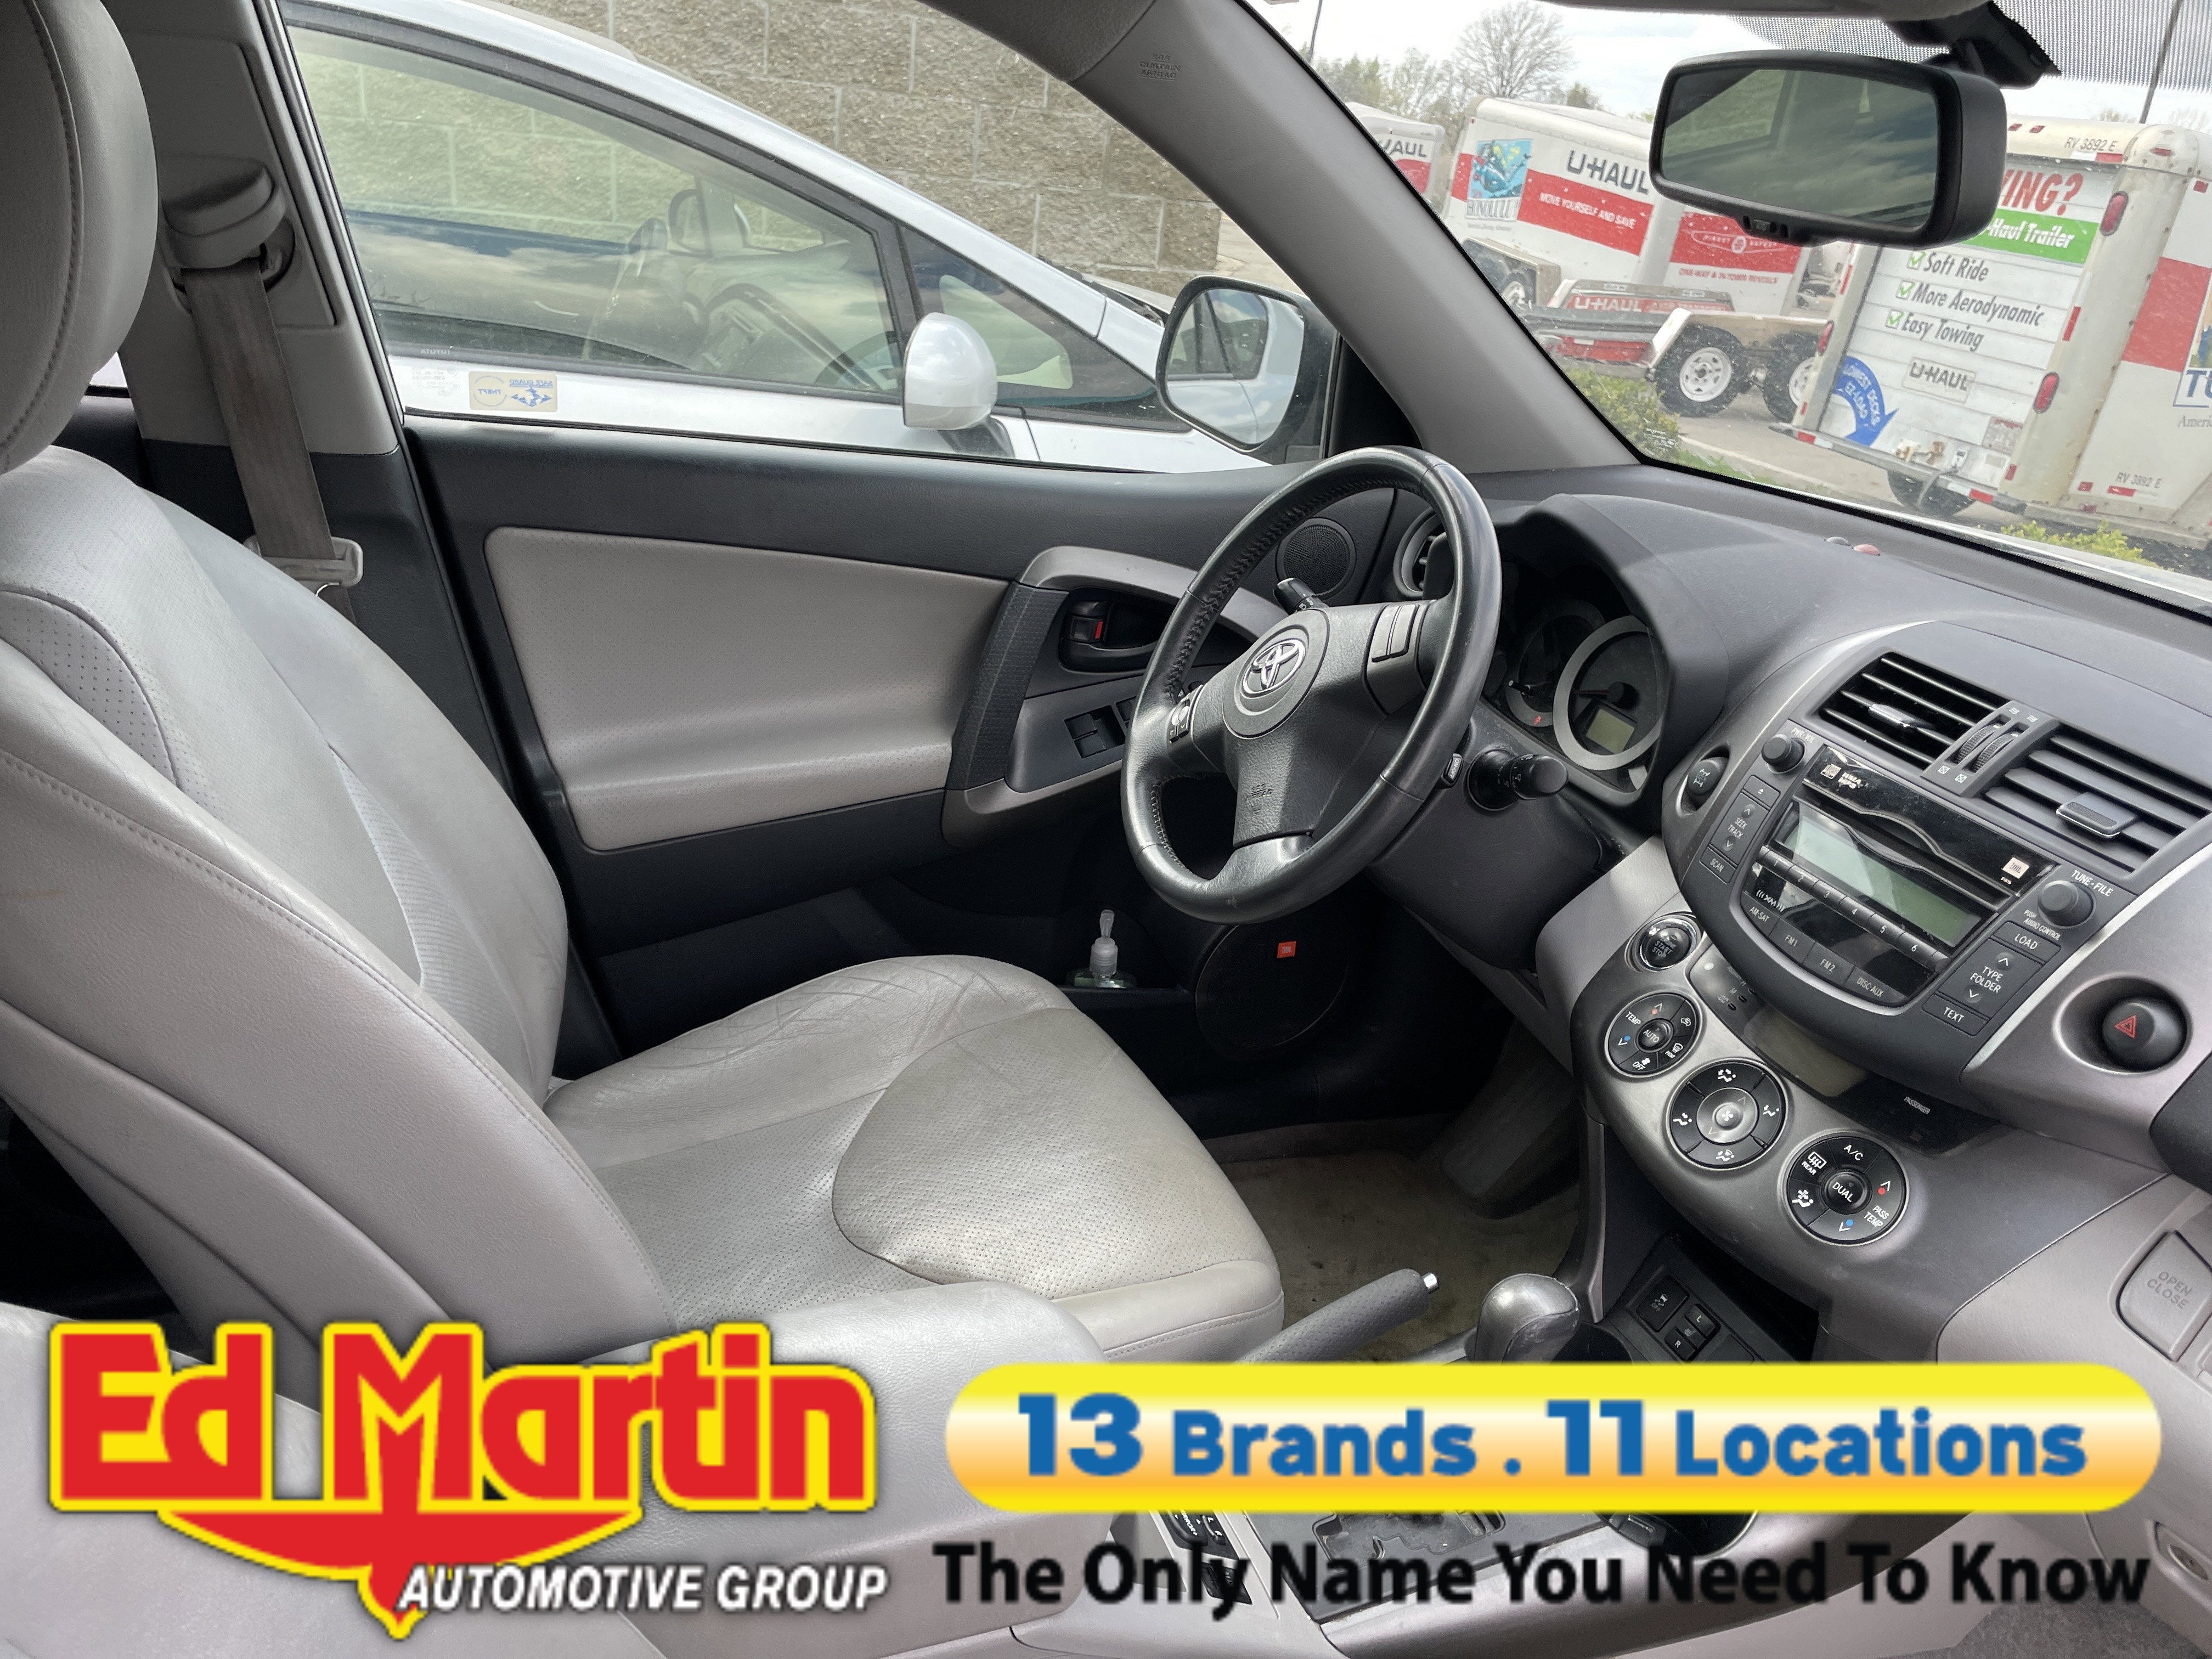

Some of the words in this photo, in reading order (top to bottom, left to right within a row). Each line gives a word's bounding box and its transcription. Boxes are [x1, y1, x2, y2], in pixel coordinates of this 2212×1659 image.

[2064, 137, 2080, 148] RV
[2108, 141, 2118, 151] E
[1566, 150, 1649, 195] U-HAUL
[1598, 210, 1615, 223] AND
[2023, 221, 2075, 249] Trailer
[1923, 251, 1956, 276] Soft
[1954, 256, 1989, 282] Ride
[1575, 297, 1642, 312] U-HAUL
[1911, 283, 1948, 307] More
[1948, 289, 2045, 327] Aerodynamic
[1901, 312, 1934, 342] Easy
[1934, 317, 1985, 353] Towing
[1909, 362, 1970, 392] U-HAUL
[1734, 817, 1748, 829] SEEK
[1727, 824, 1744, 840] TRACK
[1709, 857, 1725, 872] SCAN
[1824, 890, 1830, 899] 3
[2023, 909, 2036, 919] PUSH
[1880, 925, 1886, 933] 5
[2023, 918, 2039, 931] AUDIO
[2039, 924, 2061, 941] CONTROL
[1655, 940, 1673, 955] START
[1911, 944, 1917, 952] 6
[2014, 933, 2039, 950] LOAD
[1652, 946, 1667, 958] STOP
[1982, 966, 2004, 981] TYPE
[1970, 972, 2002, 994] FOLDER
[1626, 1011, 1642, 1026] TEMP
[1943, 1006, 1965, 1023] TEXT
[1643, 1028, 1661, 1043] AUTO
[1632, 1060, 1645, 1071] OFF
[1843, 1144, 1864, 1161] A/C
[1801, 1161, 1817, 1176] REAR
[1832, 1182, 1853, 1203] DUAL
[1864, 1211, 1884, 1229] TEMP
[1872, 1205, 1889, 1221] PASS
[2159, 1272, 2192, 1296] OPEN
[2147, 1279, 2188, 1309] CLOSE
